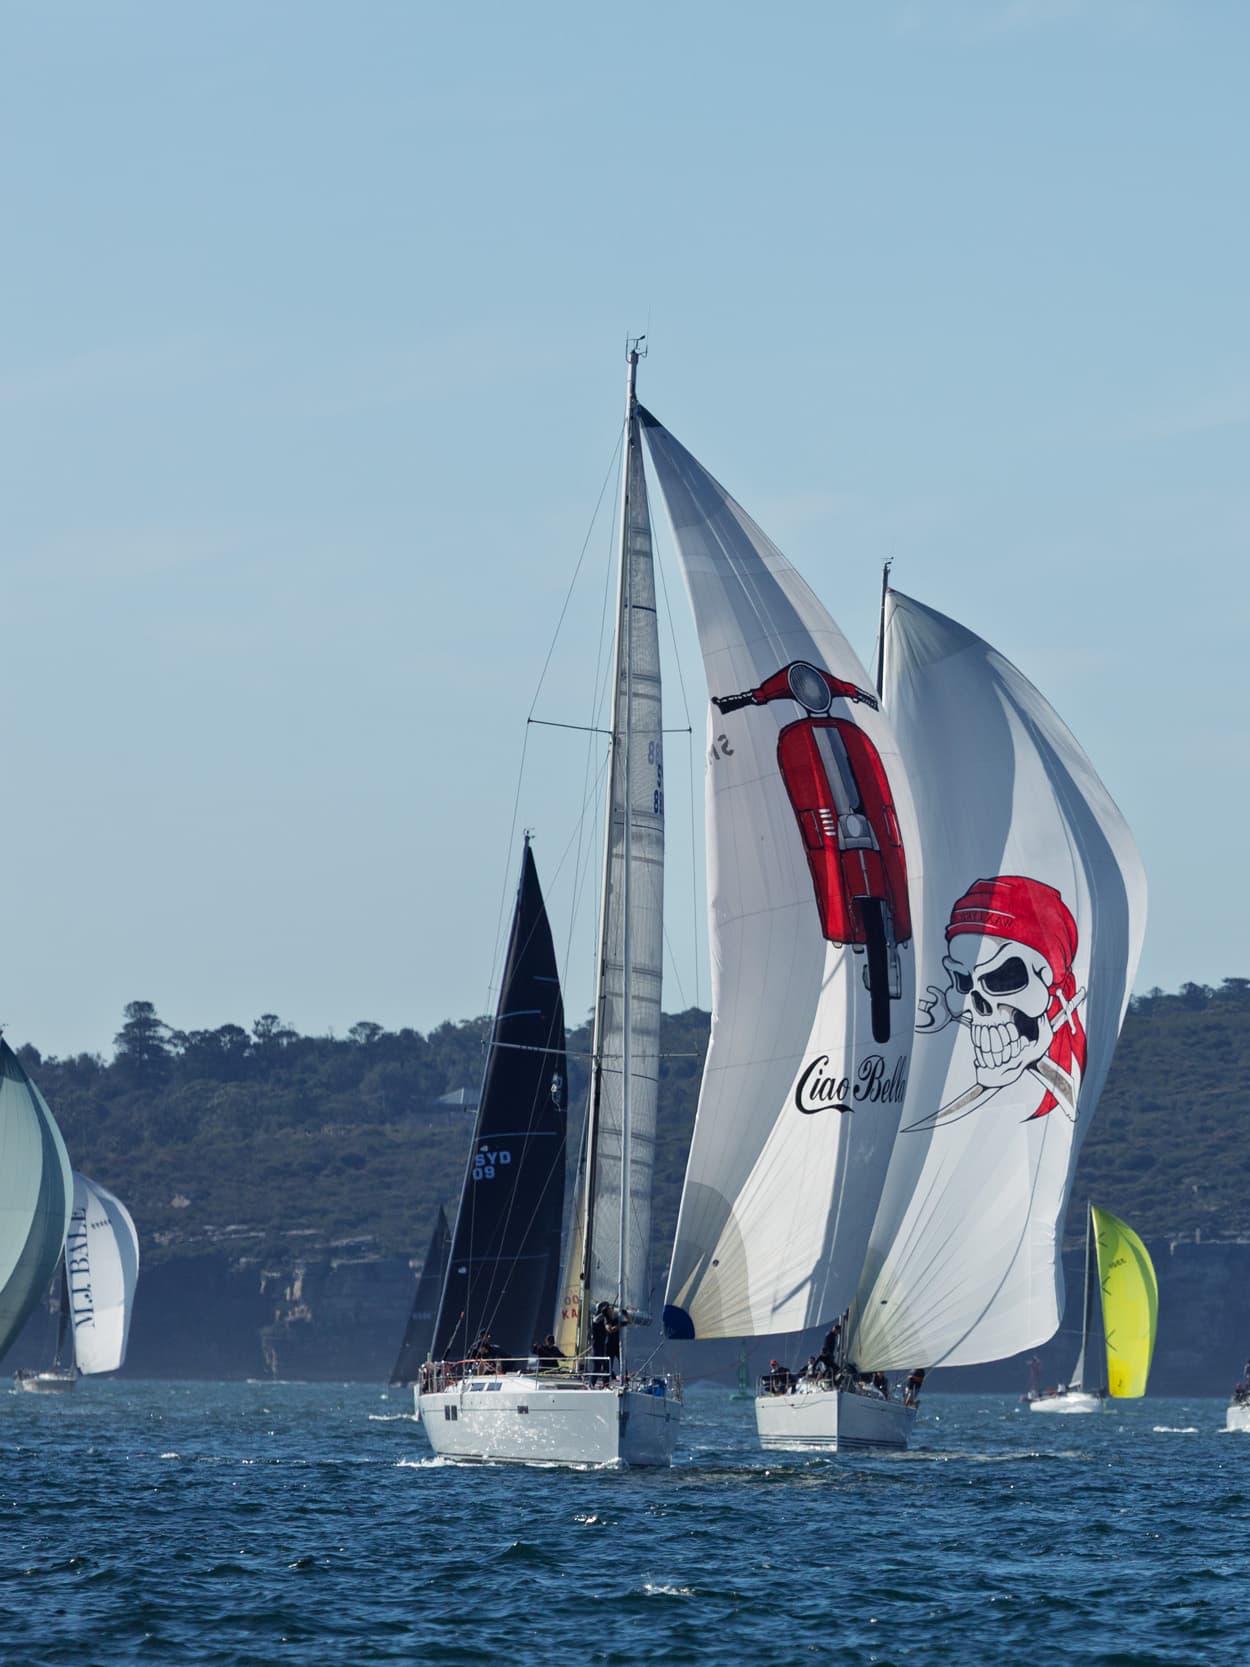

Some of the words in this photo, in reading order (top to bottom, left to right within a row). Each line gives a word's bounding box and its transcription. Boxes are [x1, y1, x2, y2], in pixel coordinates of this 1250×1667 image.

[795, 1055, 855, 1115] Ciao
[475, 1151, 511, 1167] SYD
[472, 1166, 496, 1180] 09
